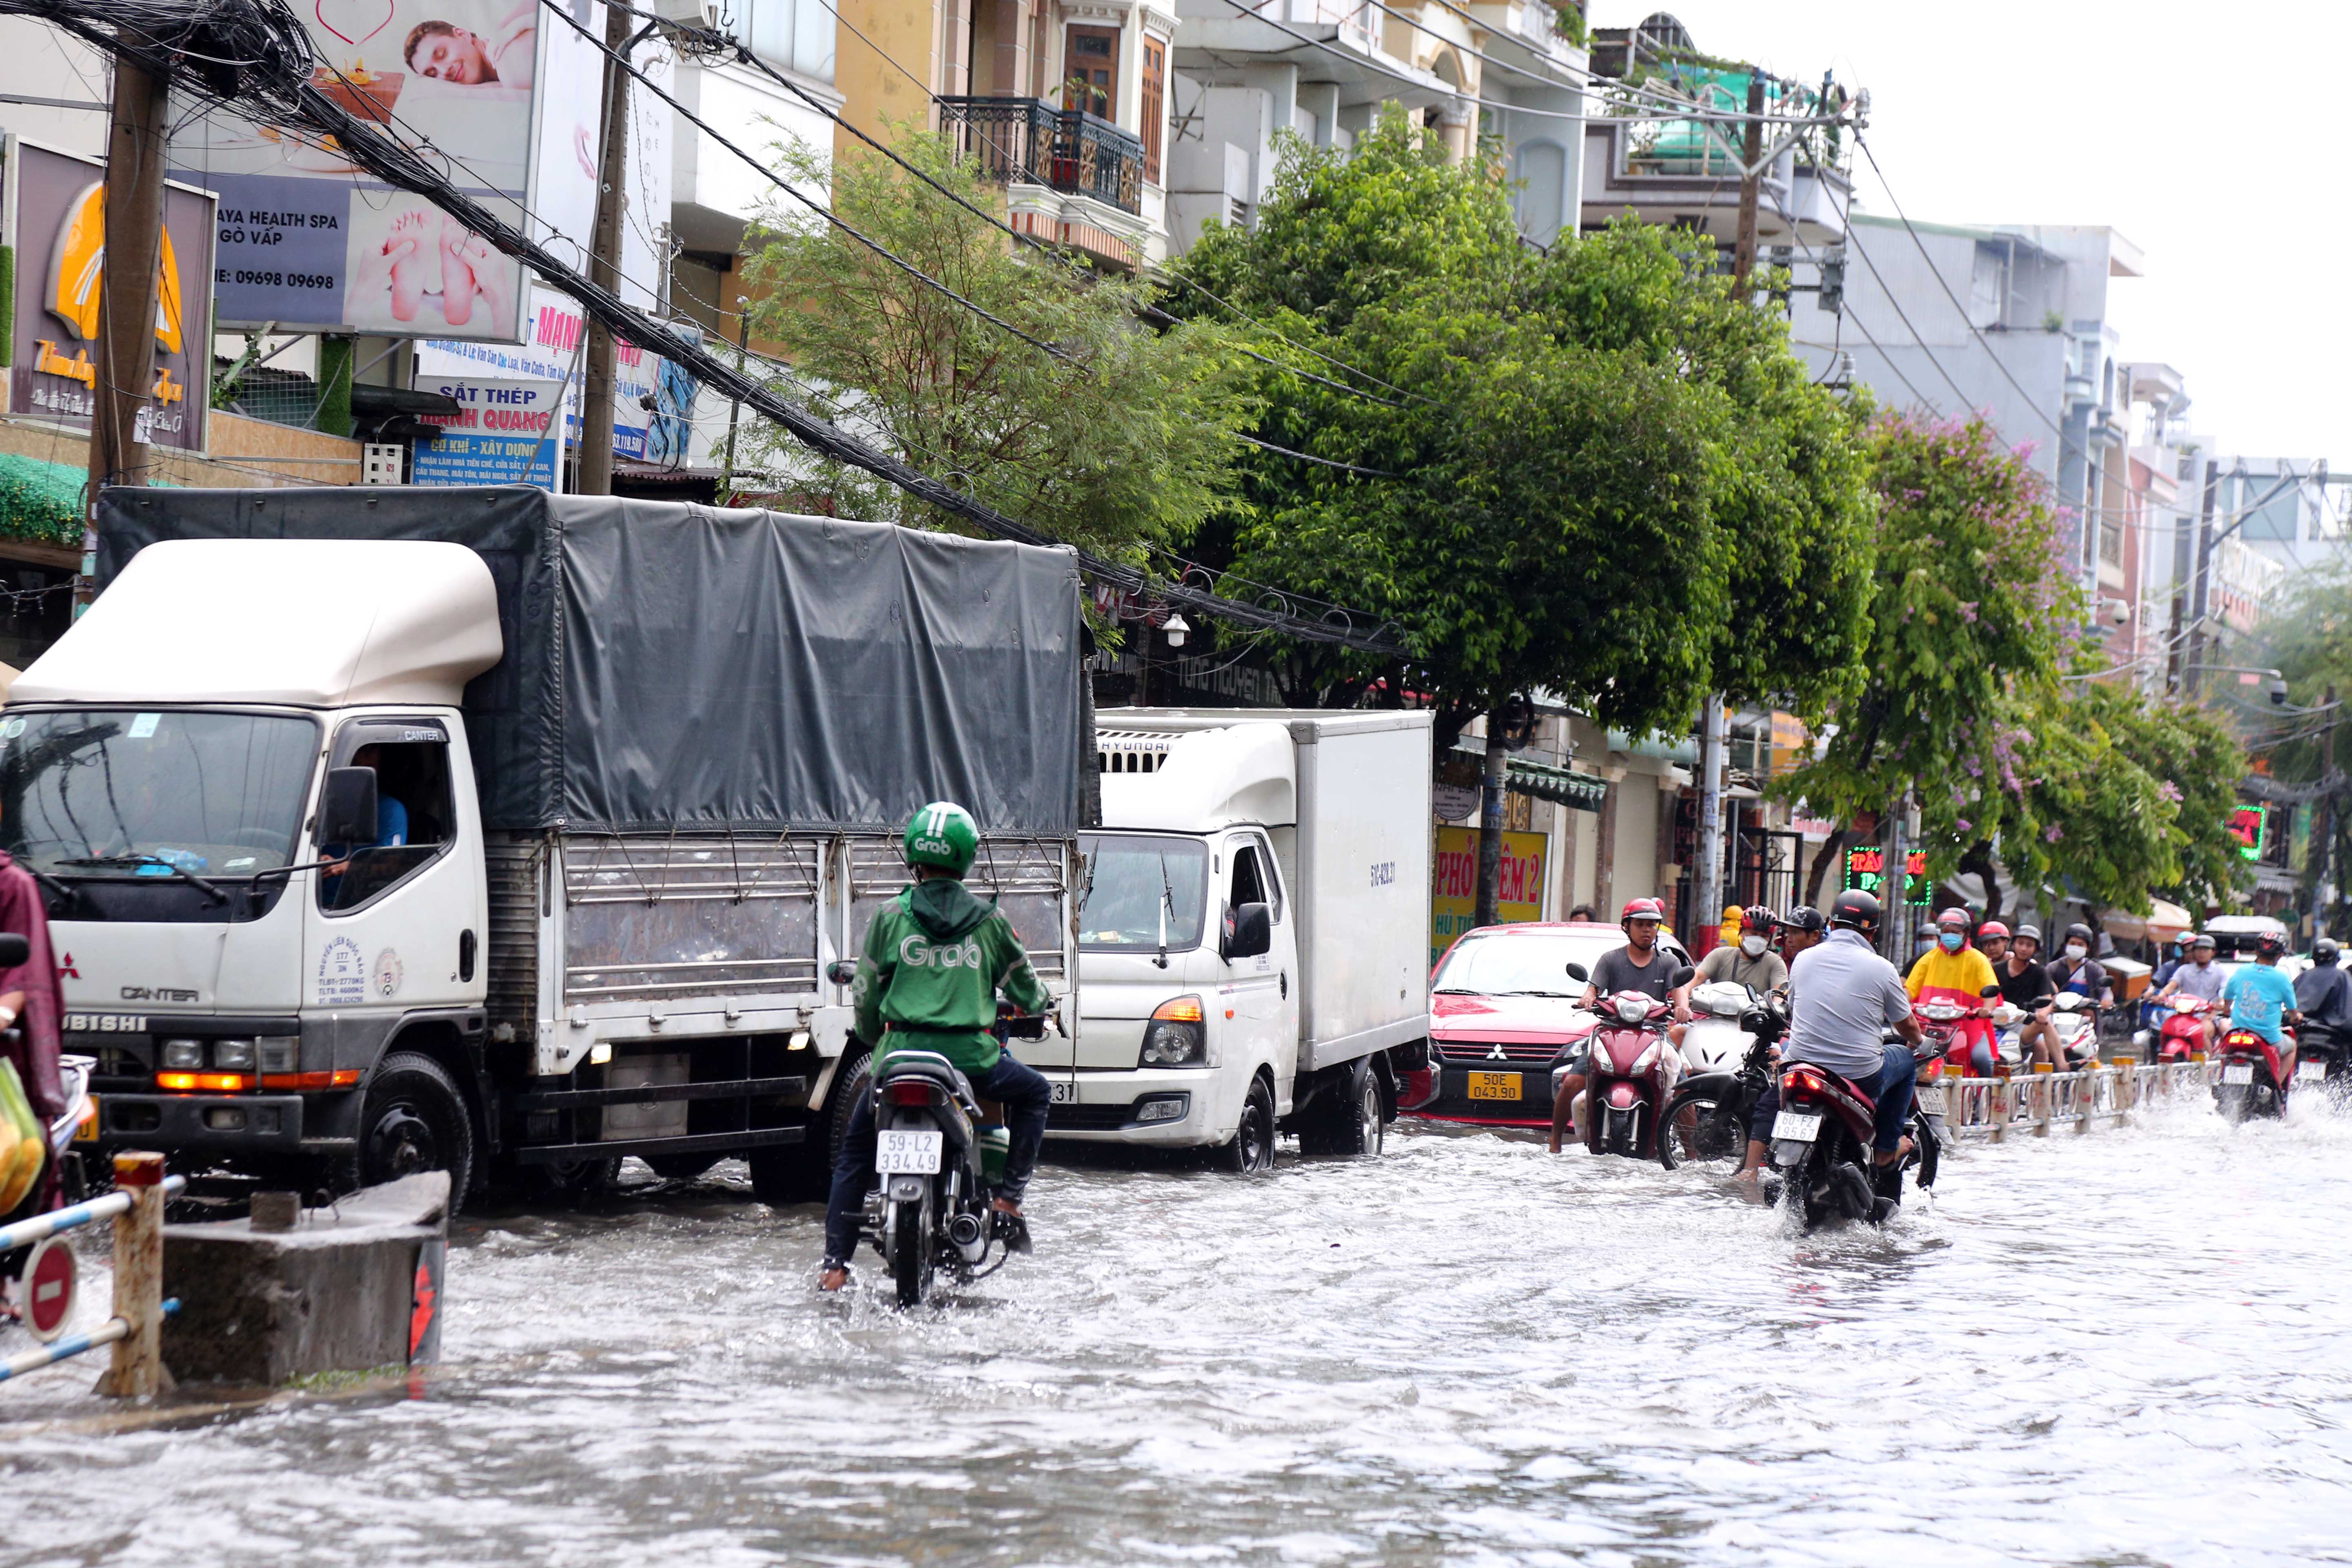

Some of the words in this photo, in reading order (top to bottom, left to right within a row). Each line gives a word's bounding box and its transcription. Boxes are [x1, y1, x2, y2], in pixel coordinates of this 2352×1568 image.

[249, 211, 305, 227] HEALTH
[310, 215, 339, 229] SPA
[220, 226, 245, 243] GÒ
[251, 226, 283, 245] VẤP
[236, 270, 282, 286] 09698
[287, 274, 334, 289] 09698
[440, 382, 479, 402] SẮT
[485, 385, 537, 404] THÉP
[483, 409, 550, 432] QUANG
[431, 439, 447, 452] CƠ
[450, 438, 469, 454] KHÍ
[480, 436, 503, 455] XÂY
[523, 462, 535, 470] LN
[405, 730, 439, 741] CANTER
[1102, 742, 1169, 751] HYUNDAI
[914, 837, 951, 855] Grab
[1437, 834, 1476, 898] PHỞ
[1528, 853, 1540, 903] 2
[1435, 909, 1454, 935] HỦ
[902, 934, 982, 969] Grab
[121, 987, 198, 1002] CANTER
[1484, 1074, 1507, 1085] 50E
[1049, 1084, 1072, 1101] .31
[1474, 1086, 1516, 1098] 043.90
[1782, 1114, 1814, 1127] 60-F2
[1776, 1126, 1815, 1140] 195.67
[889, 1135, 932, 1152] 59-L2
[881, 1154, 936, 1171] 334.49
